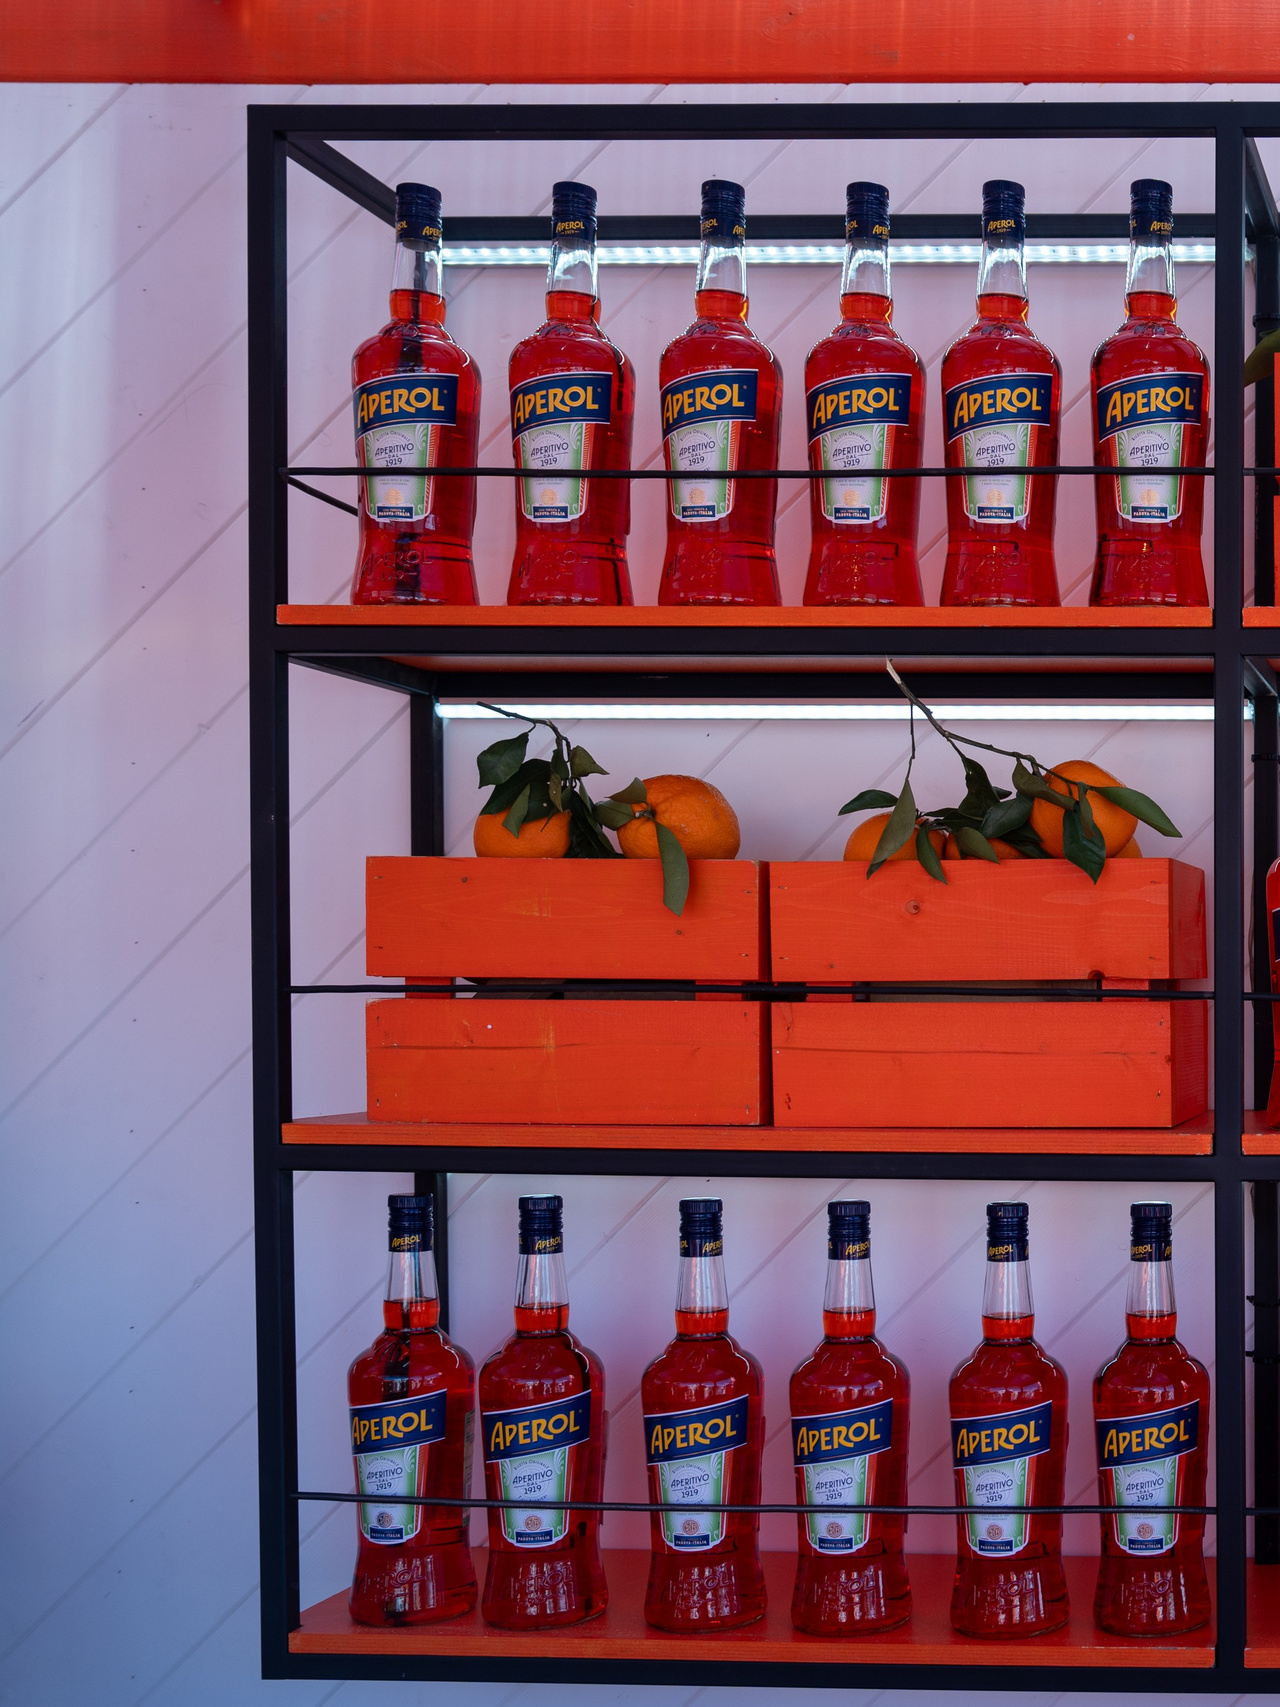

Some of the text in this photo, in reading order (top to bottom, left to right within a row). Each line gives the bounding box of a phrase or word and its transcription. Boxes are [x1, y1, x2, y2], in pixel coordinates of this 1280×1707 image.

[556, 221, 584, 233] APEROL
[988, 220, 1015, 232] APEROL
[1150, 221, 1171, 231] APERO
[357, 387, 445, 429] APEROL
[514, 386, 599, 429] APEROL
[664, 384, 745, 429] APEROL
[813, 387, 900, 428] APEROL
[954, 388, 1041, 427] APEROL
[1106, 387, 1194, 426] APEROL
[375, 442, 414, 456] APERITIVO
[531, 442, 569, 457] APERITIVO
[679, 440, 715, 457] APERITIVO
[833, 443, 871, 458] APERITIVO
[976, 441, 1016, 456] APERITIVO
[1130, 441, 1169, 455] APERITIVO
[385, 457, 402, 466] 1919
[541, 457, 557, 466] 1919
[689, 456, 704, 466] 1919
[843, 458, 860, 467] 1919
[987, 458, 1004, 466] 1919
[1141, 457, 1158, 466] 1919
[392, 1236, 420, 1248] APEROL
[535, 1237, 561, 1250] APEROL
[702, 1239, 722, 1253] APERO
[988, 1245, 1013, 1256] APEROL
[352, 1409, 433, 1445] APEROL
[491, 1411, 579, 1451] APEROL
[652, 1416, 736, 1454] APEROL
[798, 1419, 880, 1456] APEROL
[957, 1421, 1040, 1457] APEROL
[1105, 1420, 1188, 1458] APEROL
[367, 1468, 402, 1480] APERITIVO
[513, 1470, 553, 1485] APERITIVO
[671, 1474, 709, 1488] APERITIVO
[376, 1482, 392, 1490] 1919
[523, 1485, 540, 1494] 1919
[816, 1477, 853, 1491] APERITIVO
[976, 1479, 1013, 1493] APERITIVO
[1126, 1478, 1163, 1492] APERITIVO
[681, 1489, 698, 1498] 1919
[825, 1492, 842, 1501] 1919
[986, 1494, 1002, 1502] 1919
[1137, 1493, 1153, 1502] 1919
